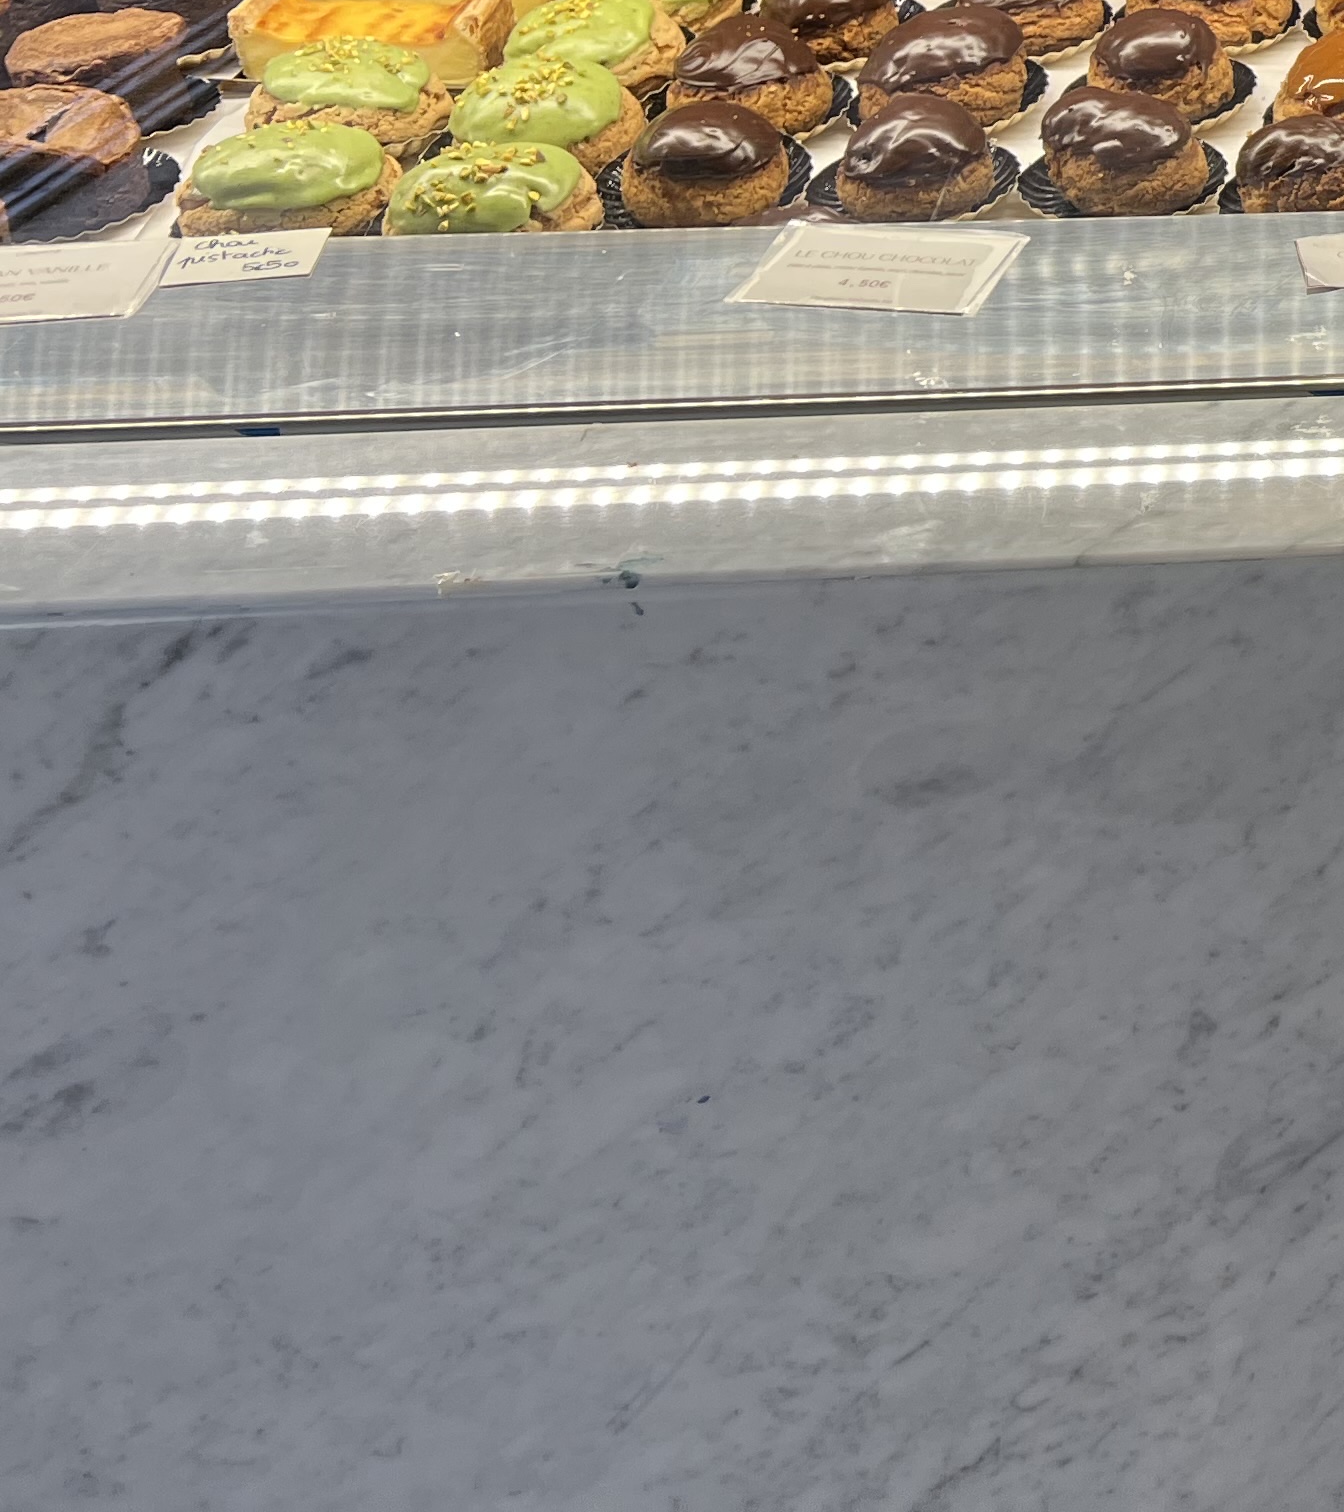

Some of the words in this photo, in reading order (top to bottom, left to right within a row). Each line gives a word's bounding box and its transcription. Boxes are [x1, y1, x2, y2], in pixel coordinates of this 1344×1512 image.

[177, 247, 293, 269] pistache
[794, 249, 818, 259] LE
[821, 250, 875, 261] CHOU
[878, 253, 978, 267] CHOCOLAT
